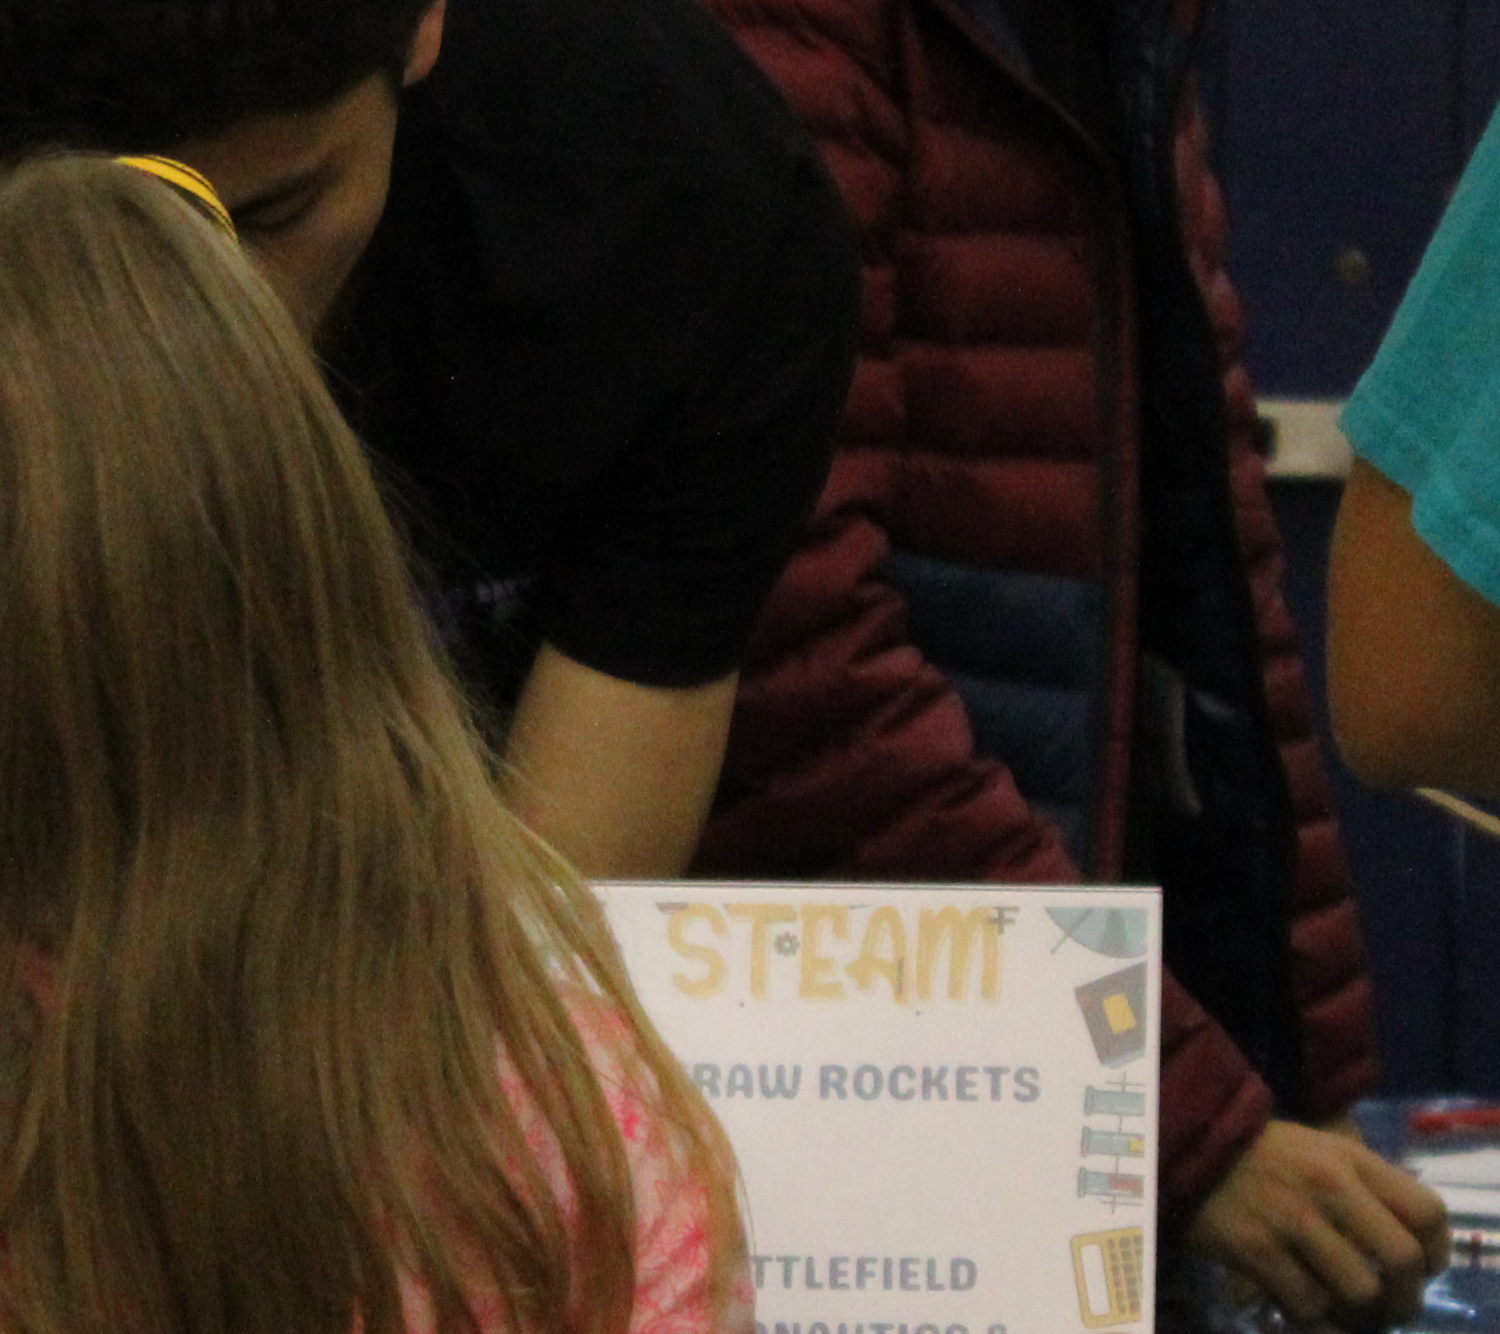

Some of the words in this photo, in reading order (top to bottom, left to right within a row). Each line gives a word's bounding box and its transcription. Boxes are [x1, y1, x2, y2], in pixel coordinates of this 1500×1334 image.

[667, 902, 1003, 1005] STEAM
[819, 1064, 1041, 1104] ROCKETS
[750, 1254, 978, 1292] TTLEFIELD
